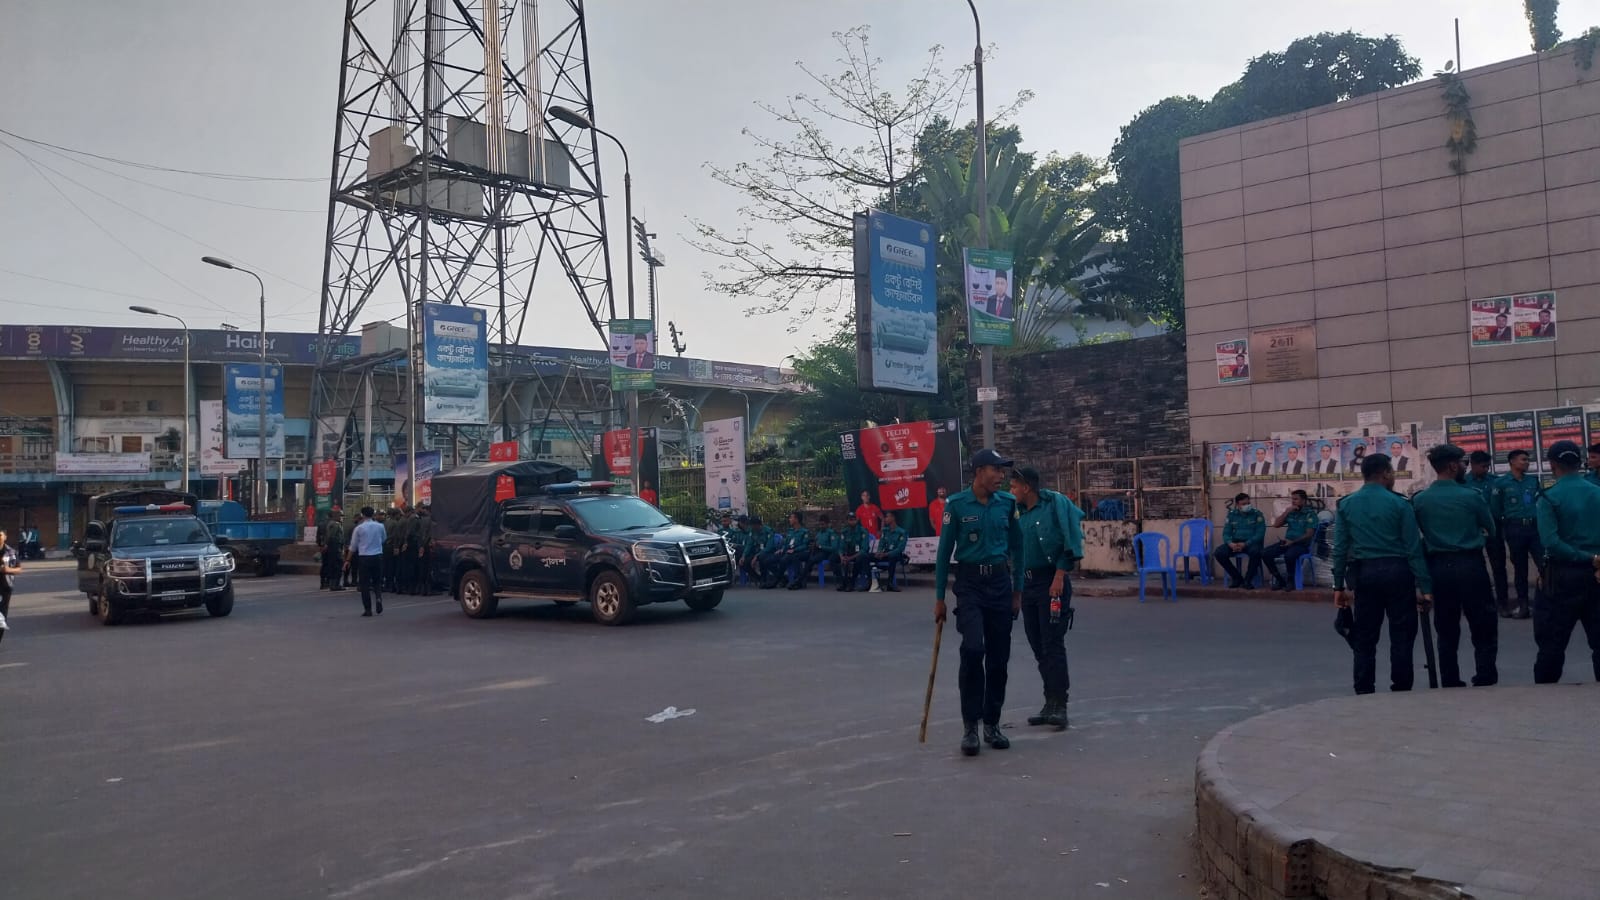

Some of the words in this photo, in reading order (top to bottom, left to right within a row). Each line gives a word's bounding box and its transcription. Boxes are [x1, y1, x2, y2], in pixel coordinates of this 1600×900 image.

[894, 246, 913, 257] GREE
[884, 274, 902, 288] একটু
[122, 335, 169, 347] Healthy
[840, 433, 854, 443] 18
[885, 428, 910, 437] TECNO
[541, 556, 566, 569] পুলিশ
